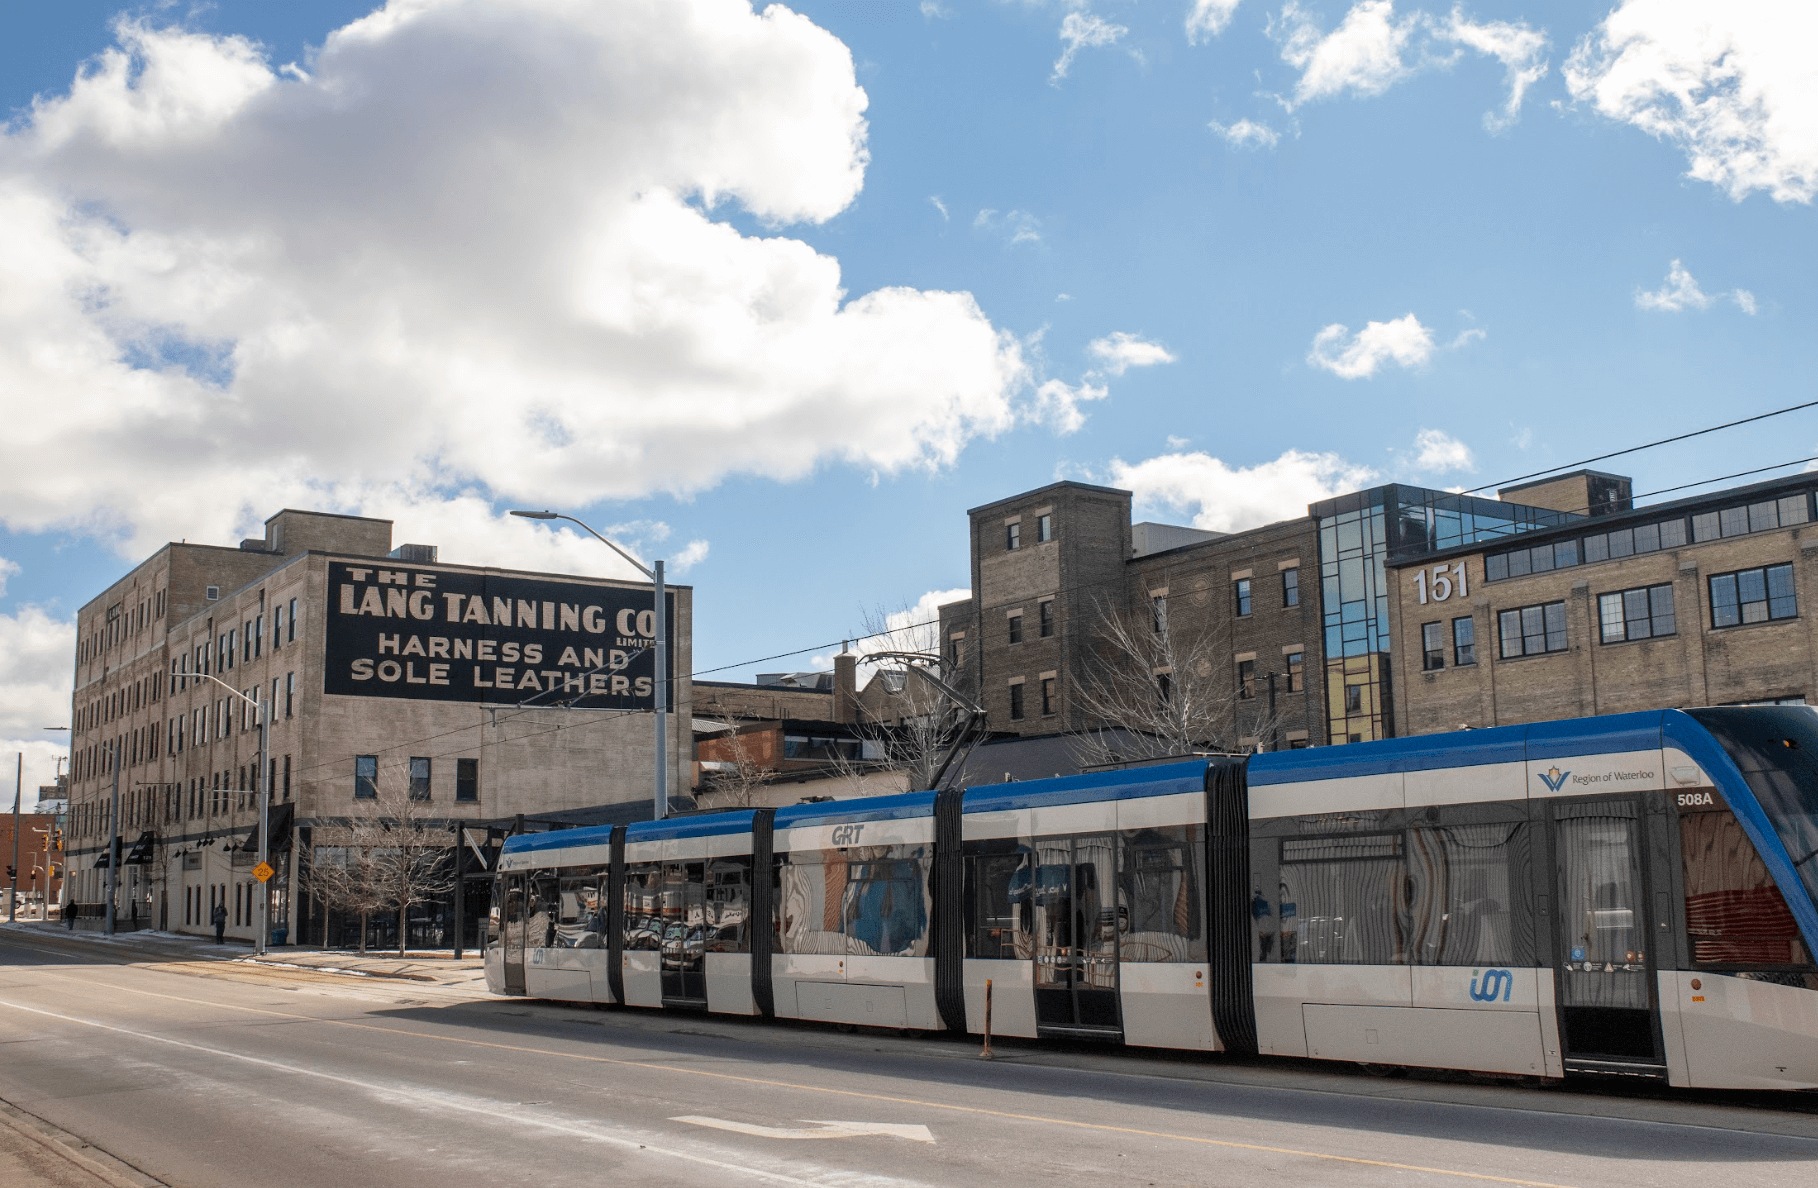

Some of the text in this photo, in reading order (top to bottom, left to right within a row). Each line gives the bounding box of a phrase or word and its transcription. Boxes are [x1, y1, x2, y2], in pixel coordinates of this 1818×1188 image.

[346, 567, 437, 588] THE
[1413, 561, 1468, 605] 151
[340, 584, 434, 621] LANG
[443, 592, 606, 634] TANNING
[378, 633, 629, 670] HARNESS AND
[351, 658, 653, 697] SOLE LEATHERS
[1572, 770, 1655, 786] Region of Waterloo
[1677, 793, 1713, 806] 508A
[831, 824, 865, 845] GRT
[257, 868, 269, 876] 25
